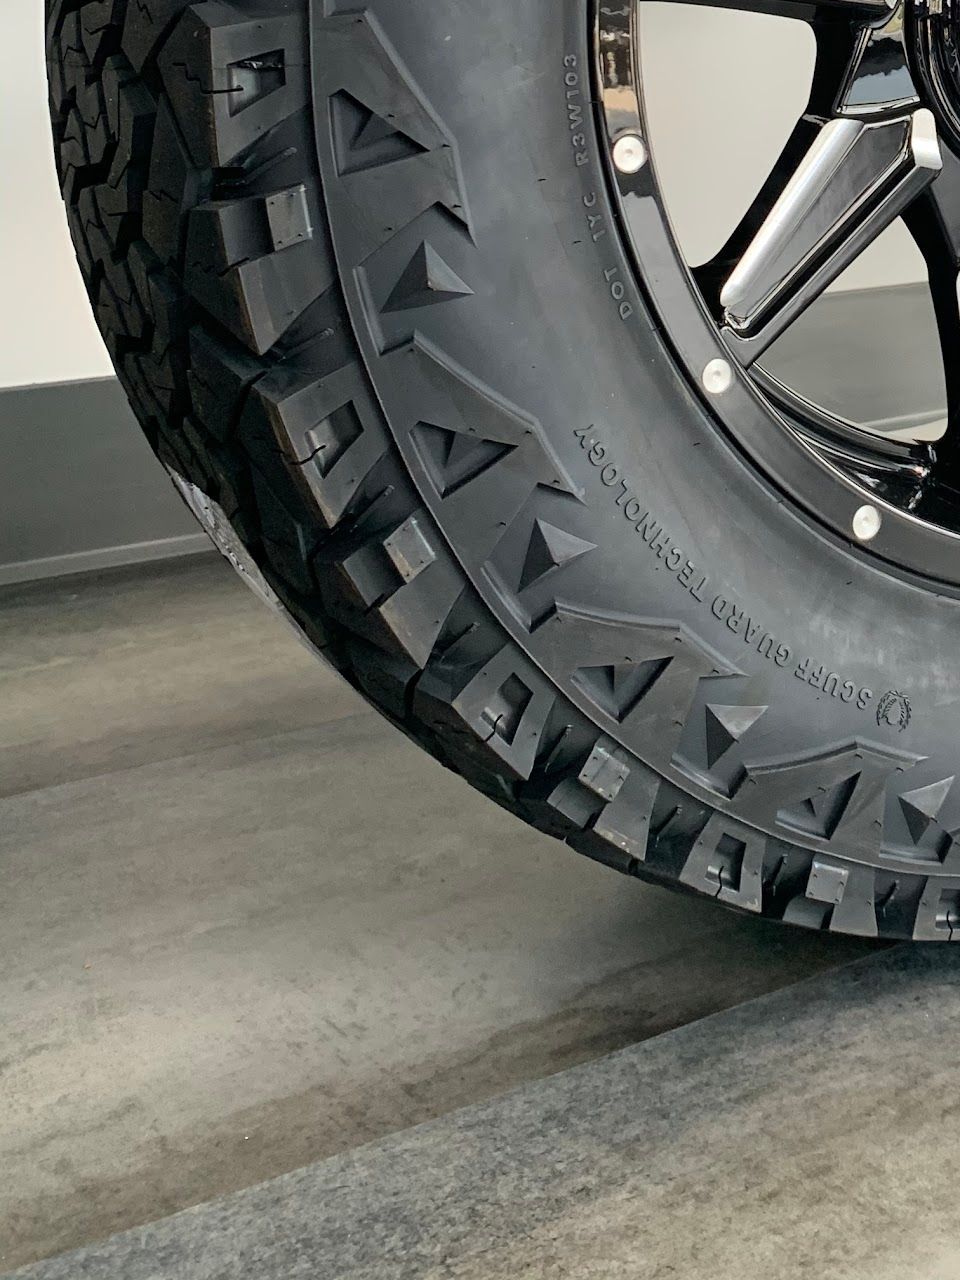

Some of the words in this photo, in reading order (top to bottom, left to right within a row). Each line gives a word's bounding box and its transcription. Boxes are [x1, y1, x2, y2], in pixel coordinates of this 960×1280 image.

[563, 53, 590, 167] R3W103
[602, 266, 634, 321] DOT
[573, 423, 707, 603] TECHNOLOGY
[711, 593, 793, 668] GUARD
[795, 657, 874, 711] SCUFF
